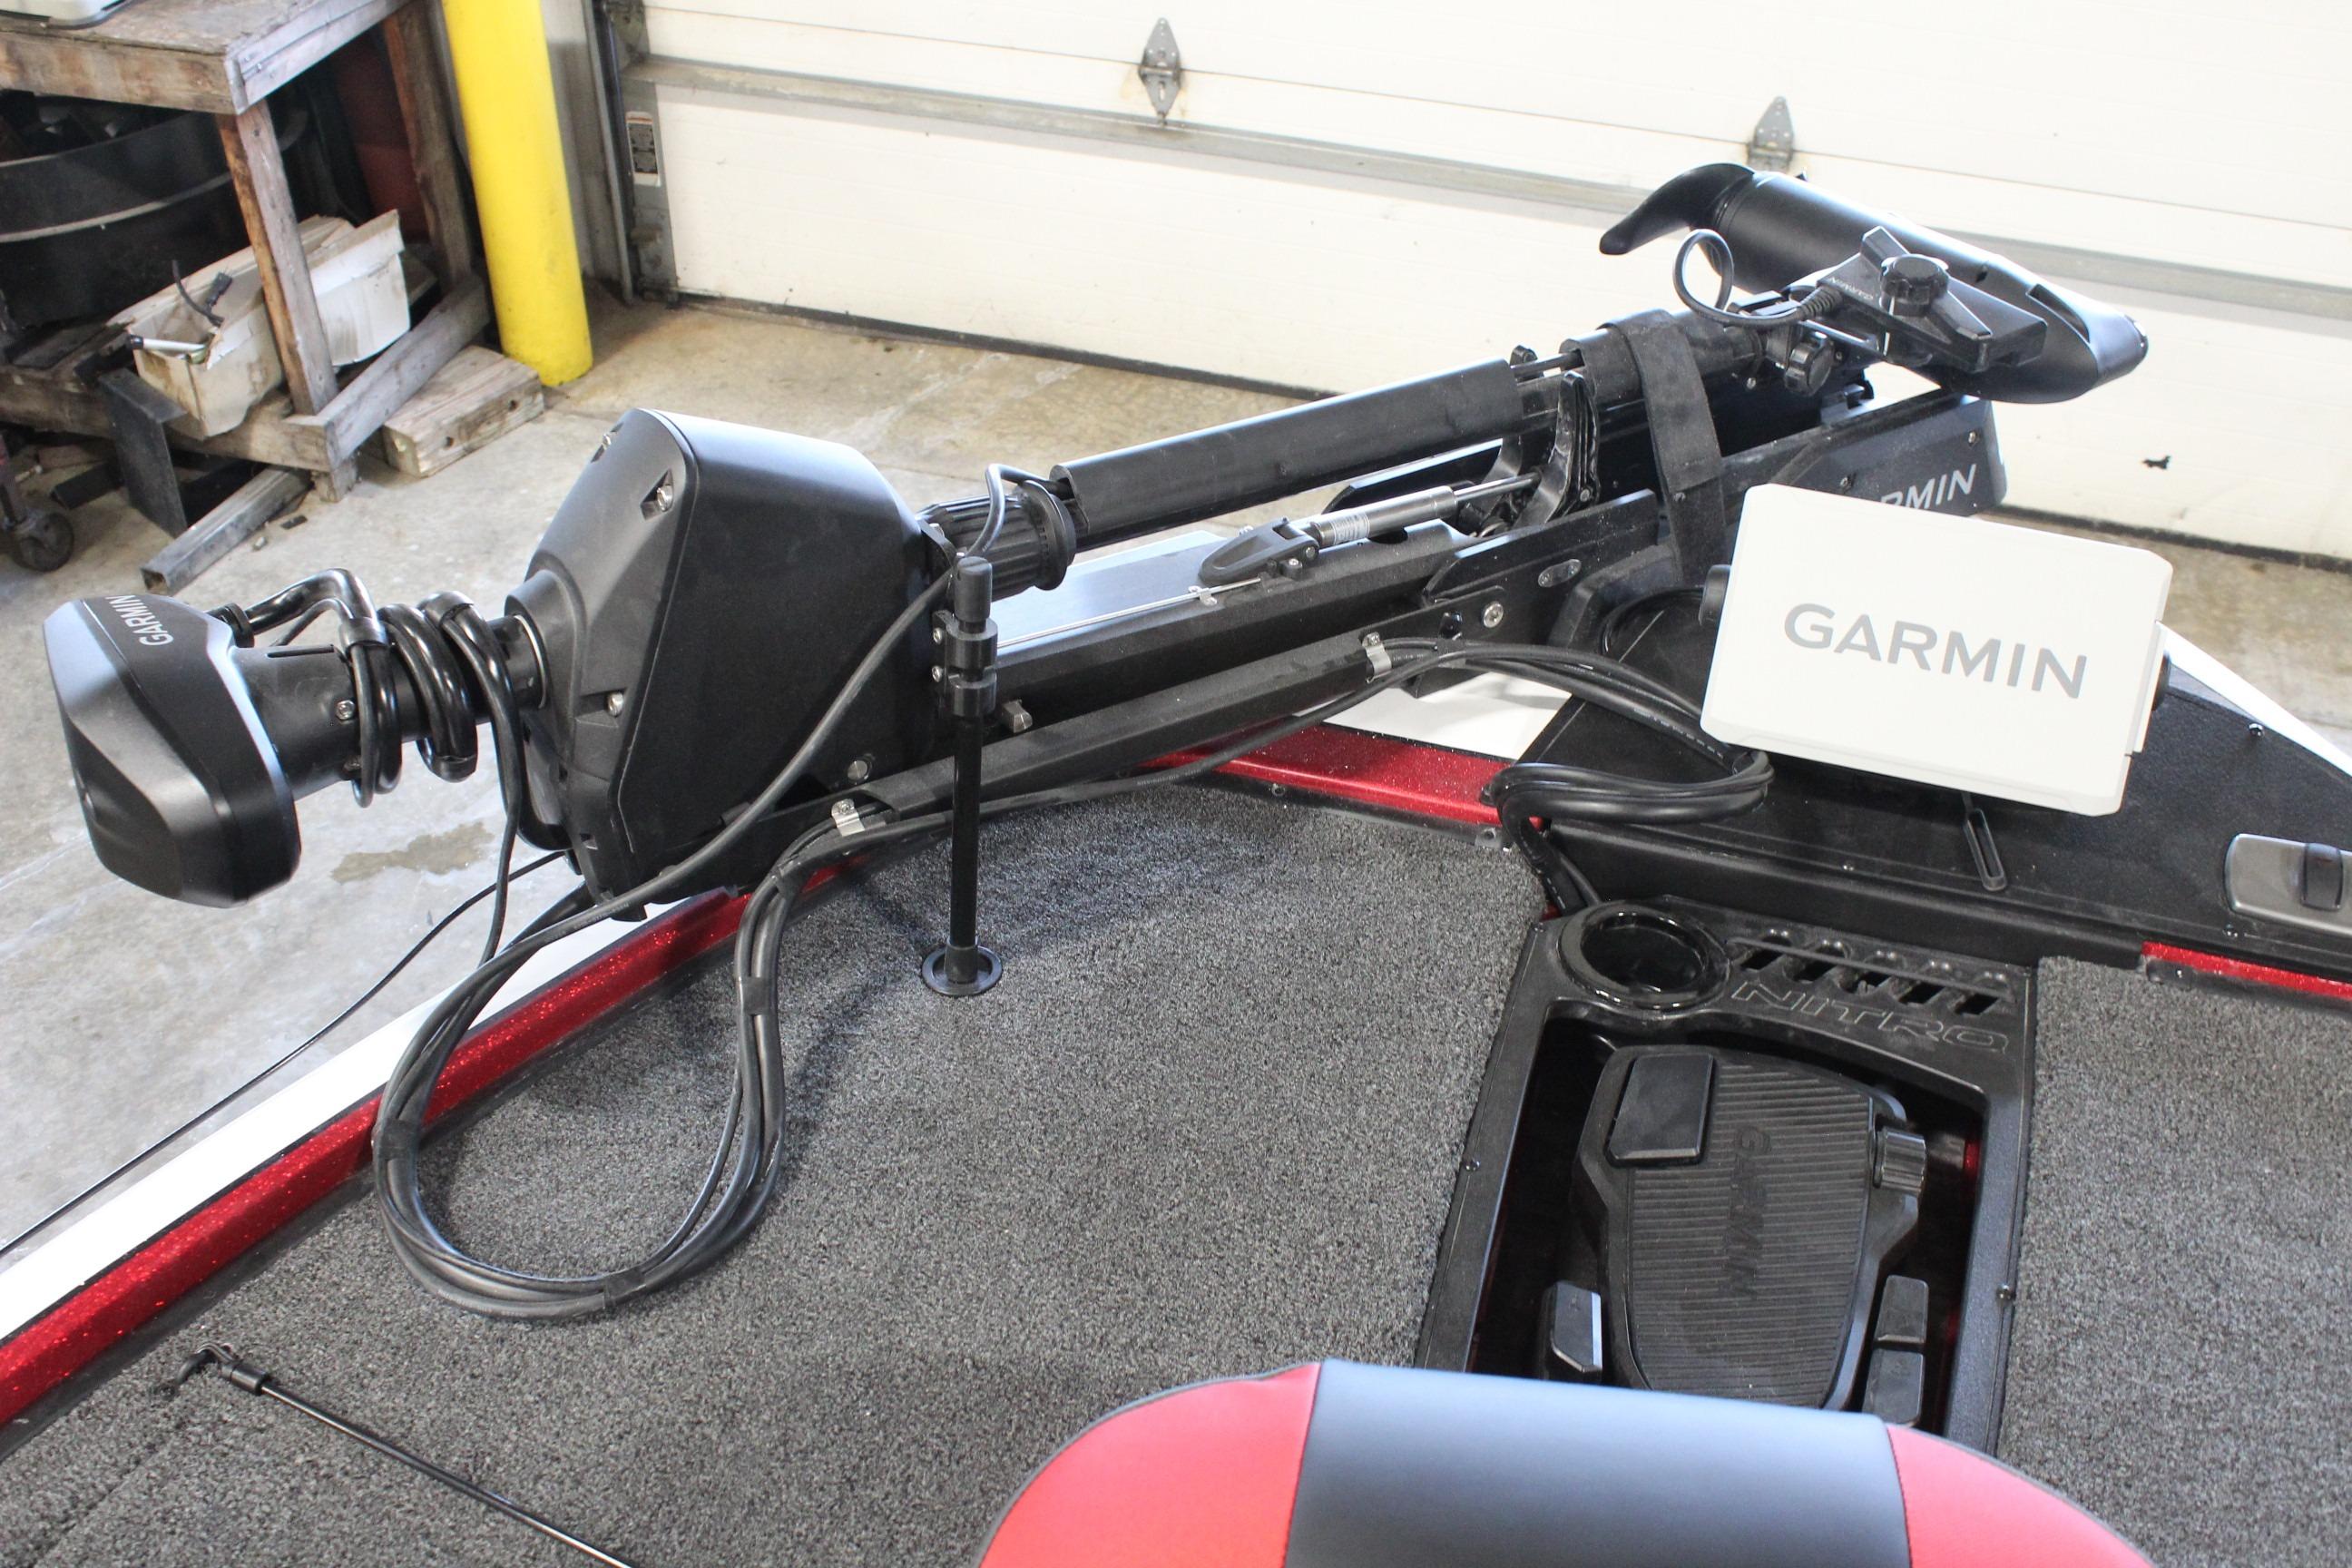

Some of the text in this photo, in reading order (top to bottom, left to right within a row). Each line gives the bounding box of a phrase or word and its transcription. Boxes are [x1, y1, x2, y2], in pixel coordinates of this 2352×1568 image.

[1880, 463, 1977, 509] MIN
[105, 594, 174, 646] GARMIN
[1784, 603, 2087, 699] GARMIN
[1730, 980, 2009, 1054] NITRO
